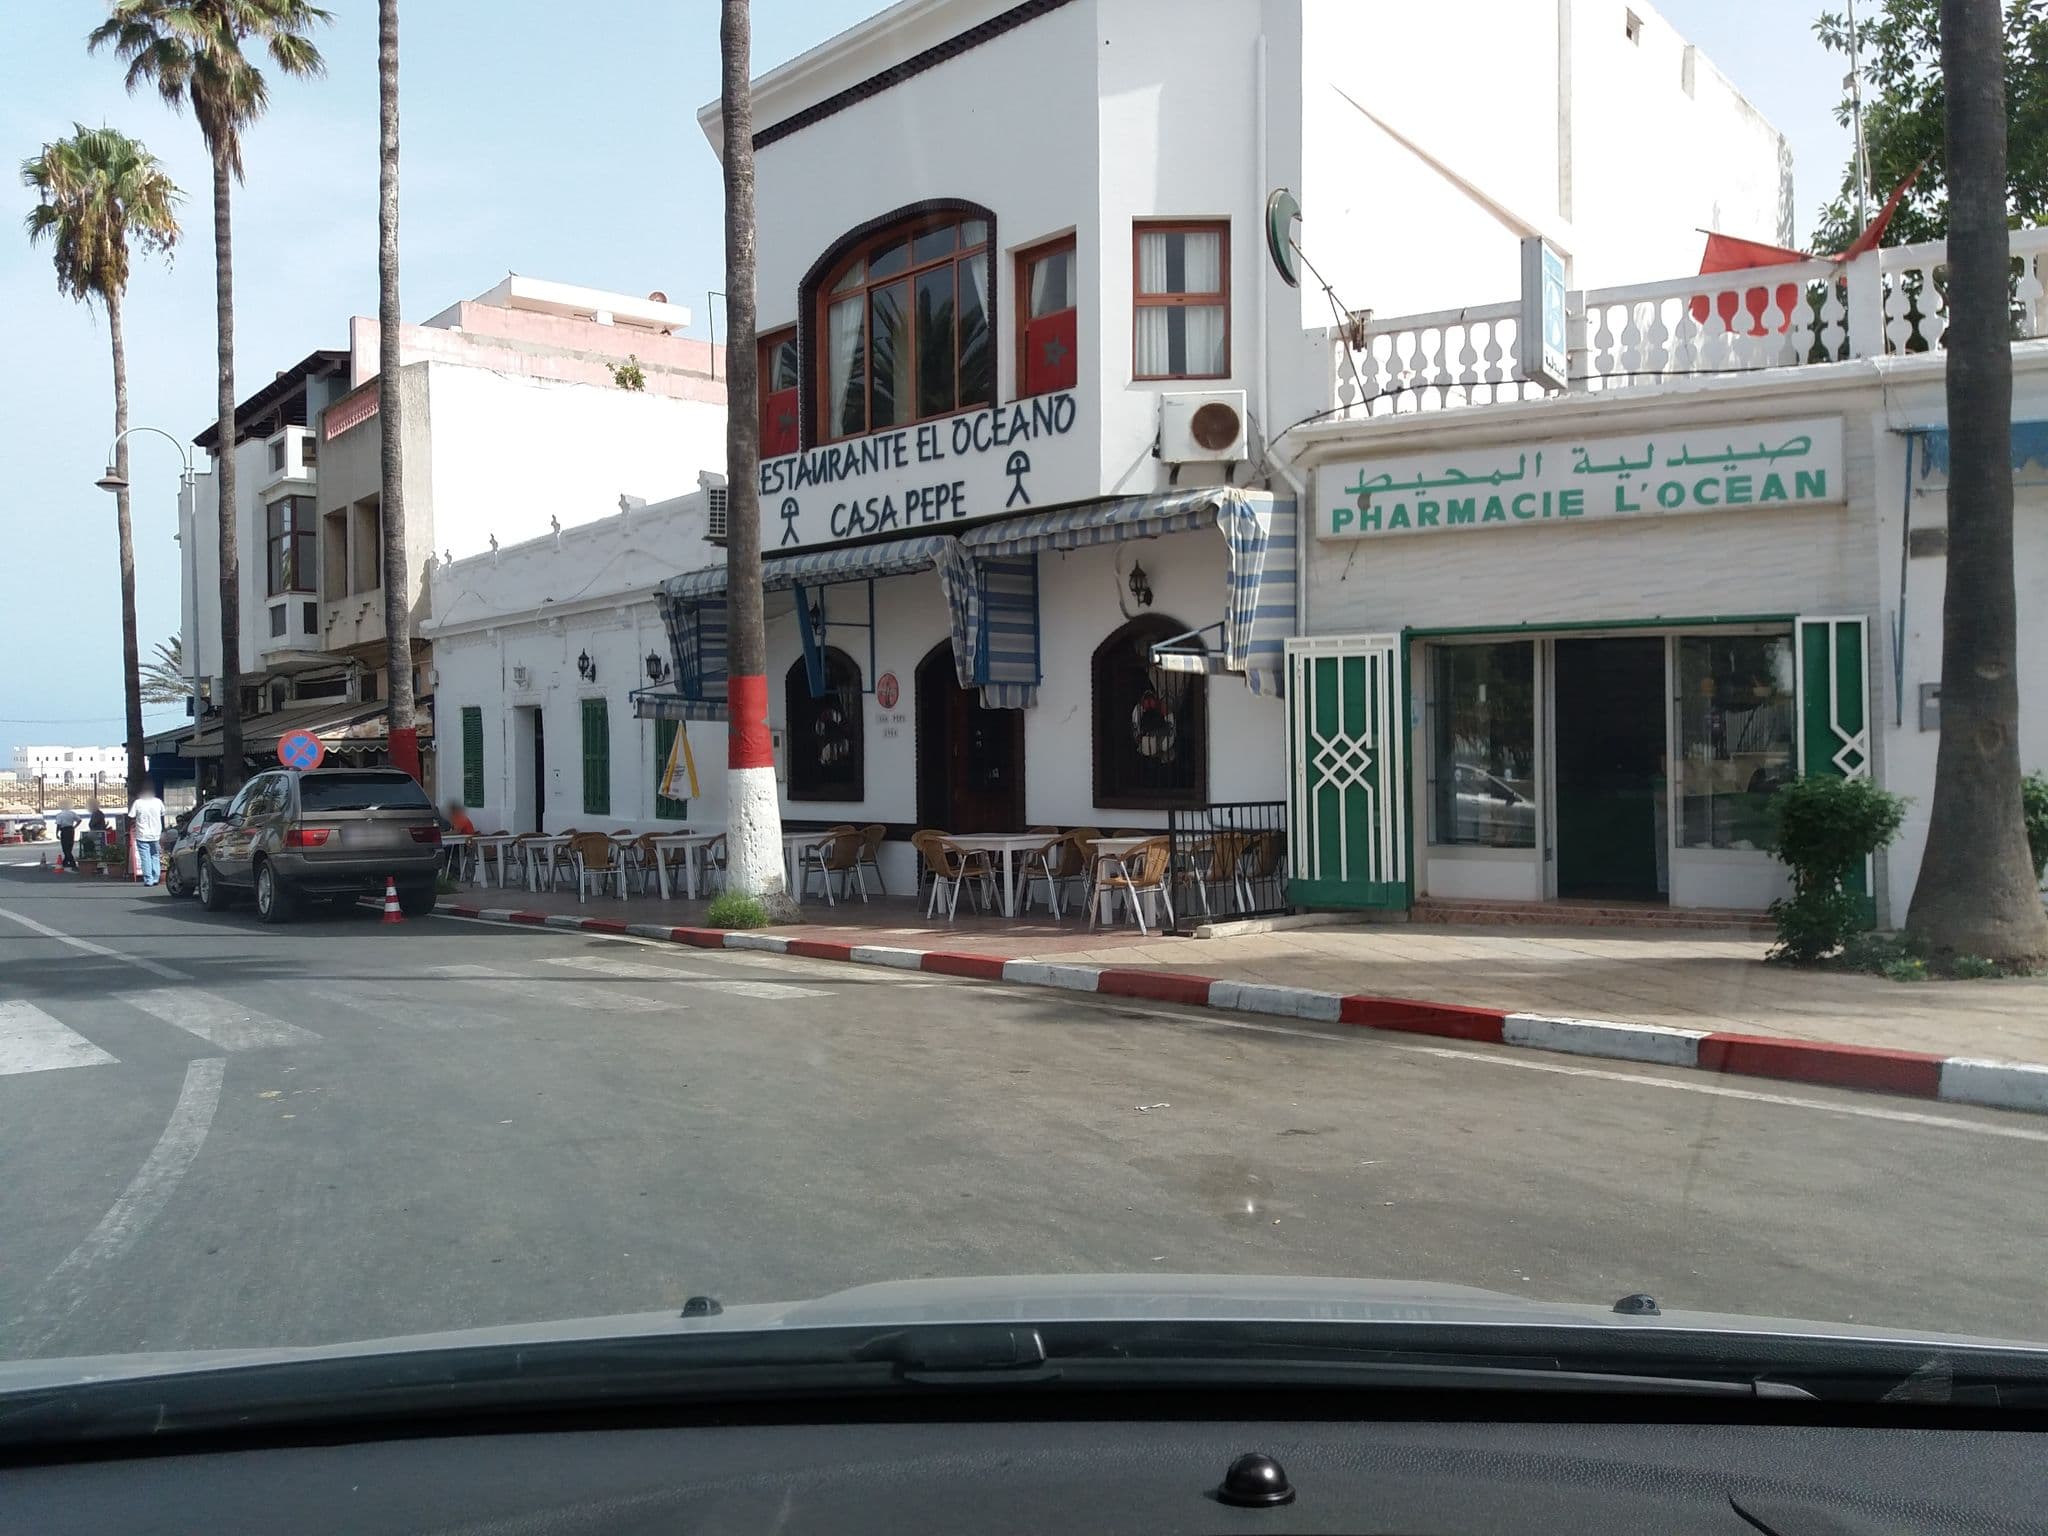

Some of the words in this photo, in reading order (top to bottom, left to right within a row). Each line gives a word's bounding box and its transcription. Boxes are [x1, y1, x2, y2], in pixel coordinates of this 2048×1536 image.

[757, 432, 909, 498] ESTAURANTE
[917, 425, 945, 462] EL
[952, 393, 1077, 456] OCEANO
[1343, 450, 1543, 498] المحيط
[1572, 434, 1813, 479] صيدلية
[830, 495, 899, 538] CASA
[905, 480, 967, 526] PEPE
[1331, 488, 1585, 533] PHARMACIE
[1614, 468, 1828, 513] L'OCEAN
